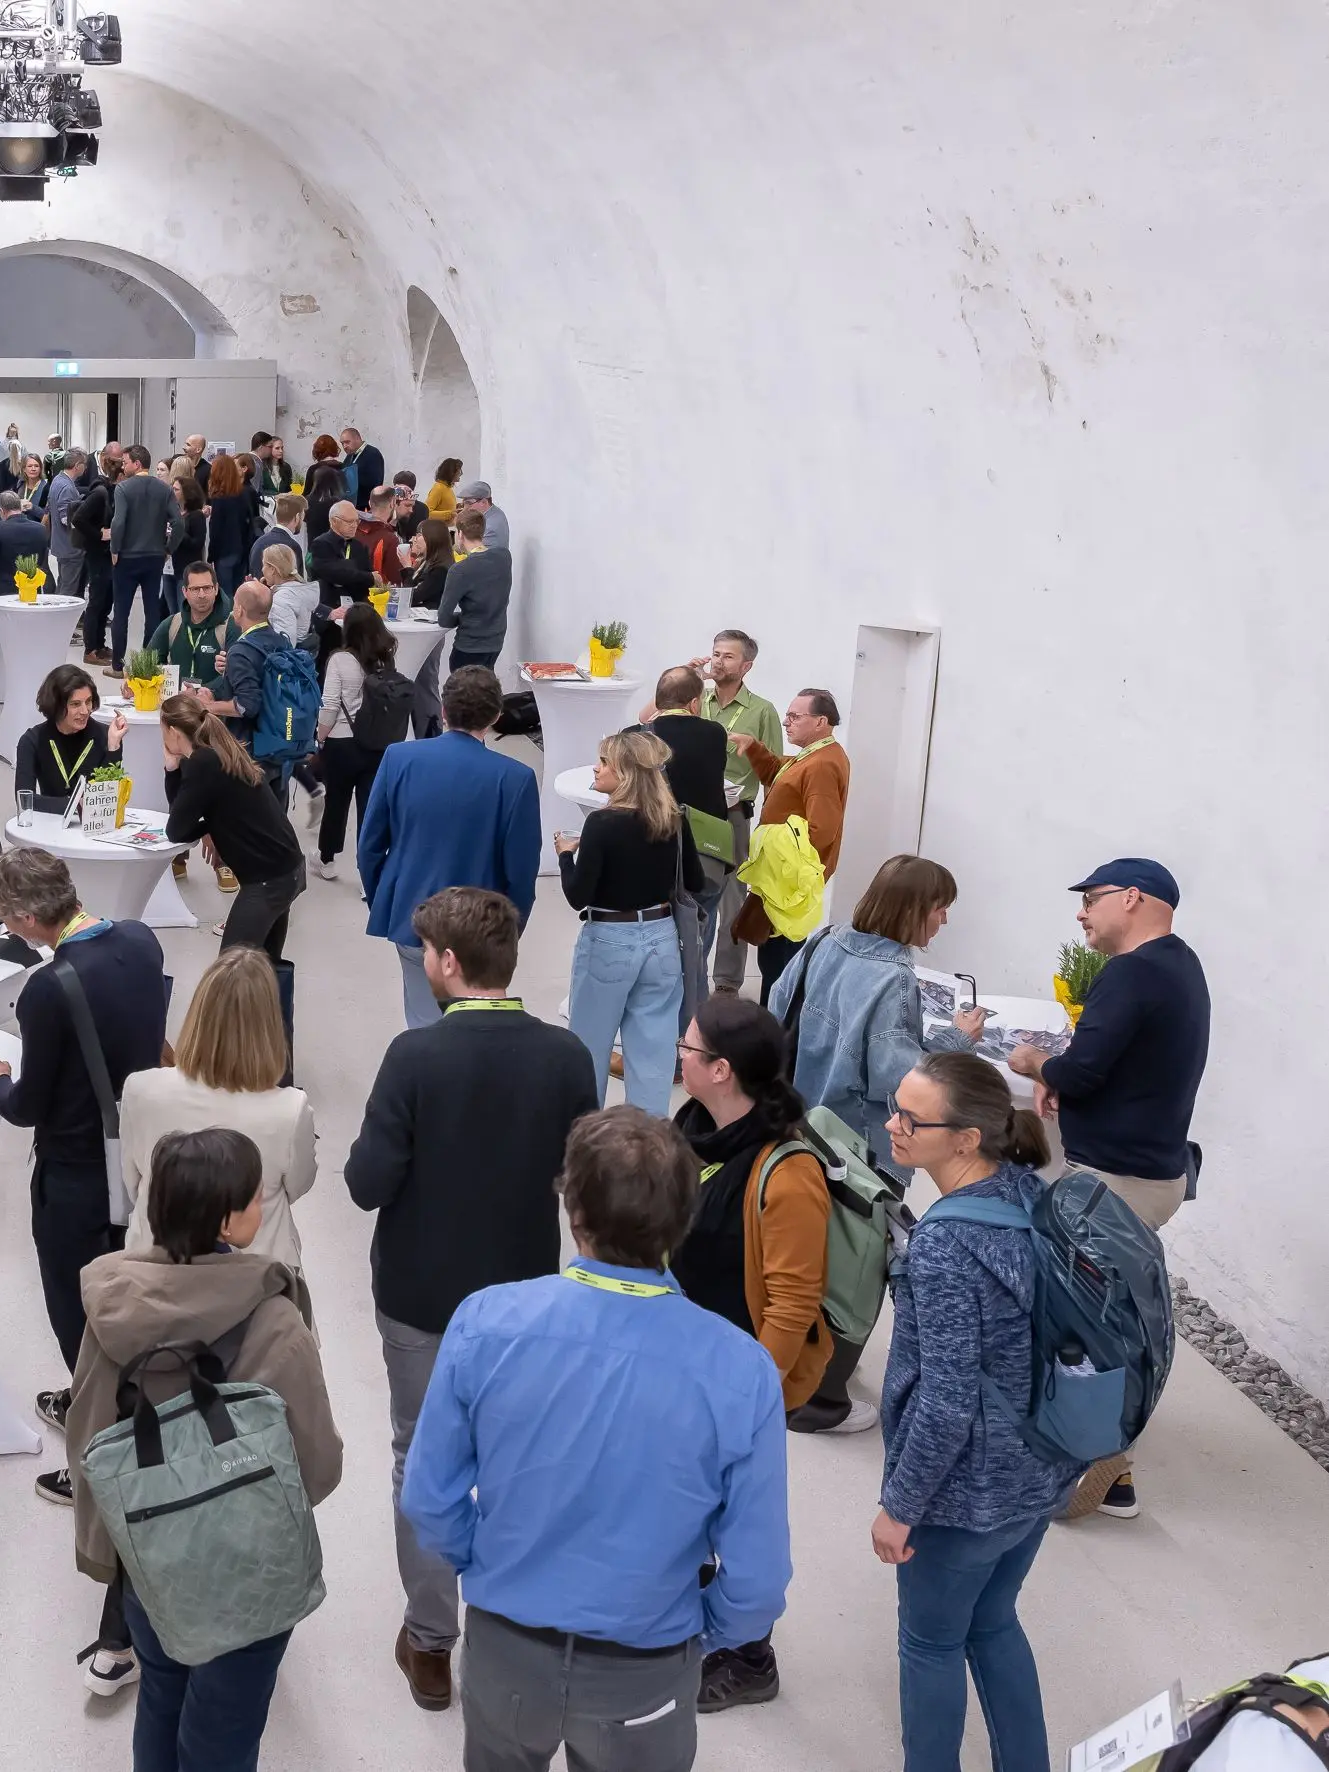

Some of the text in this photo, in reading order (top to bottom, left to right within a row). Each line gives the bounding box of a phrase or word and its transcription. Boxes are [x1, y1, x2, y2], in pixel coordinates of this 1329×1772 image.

[84, 783, 104, 793] Rad
[85, 795, 117, 806] fahren
[103, 807, 116, 817] für
